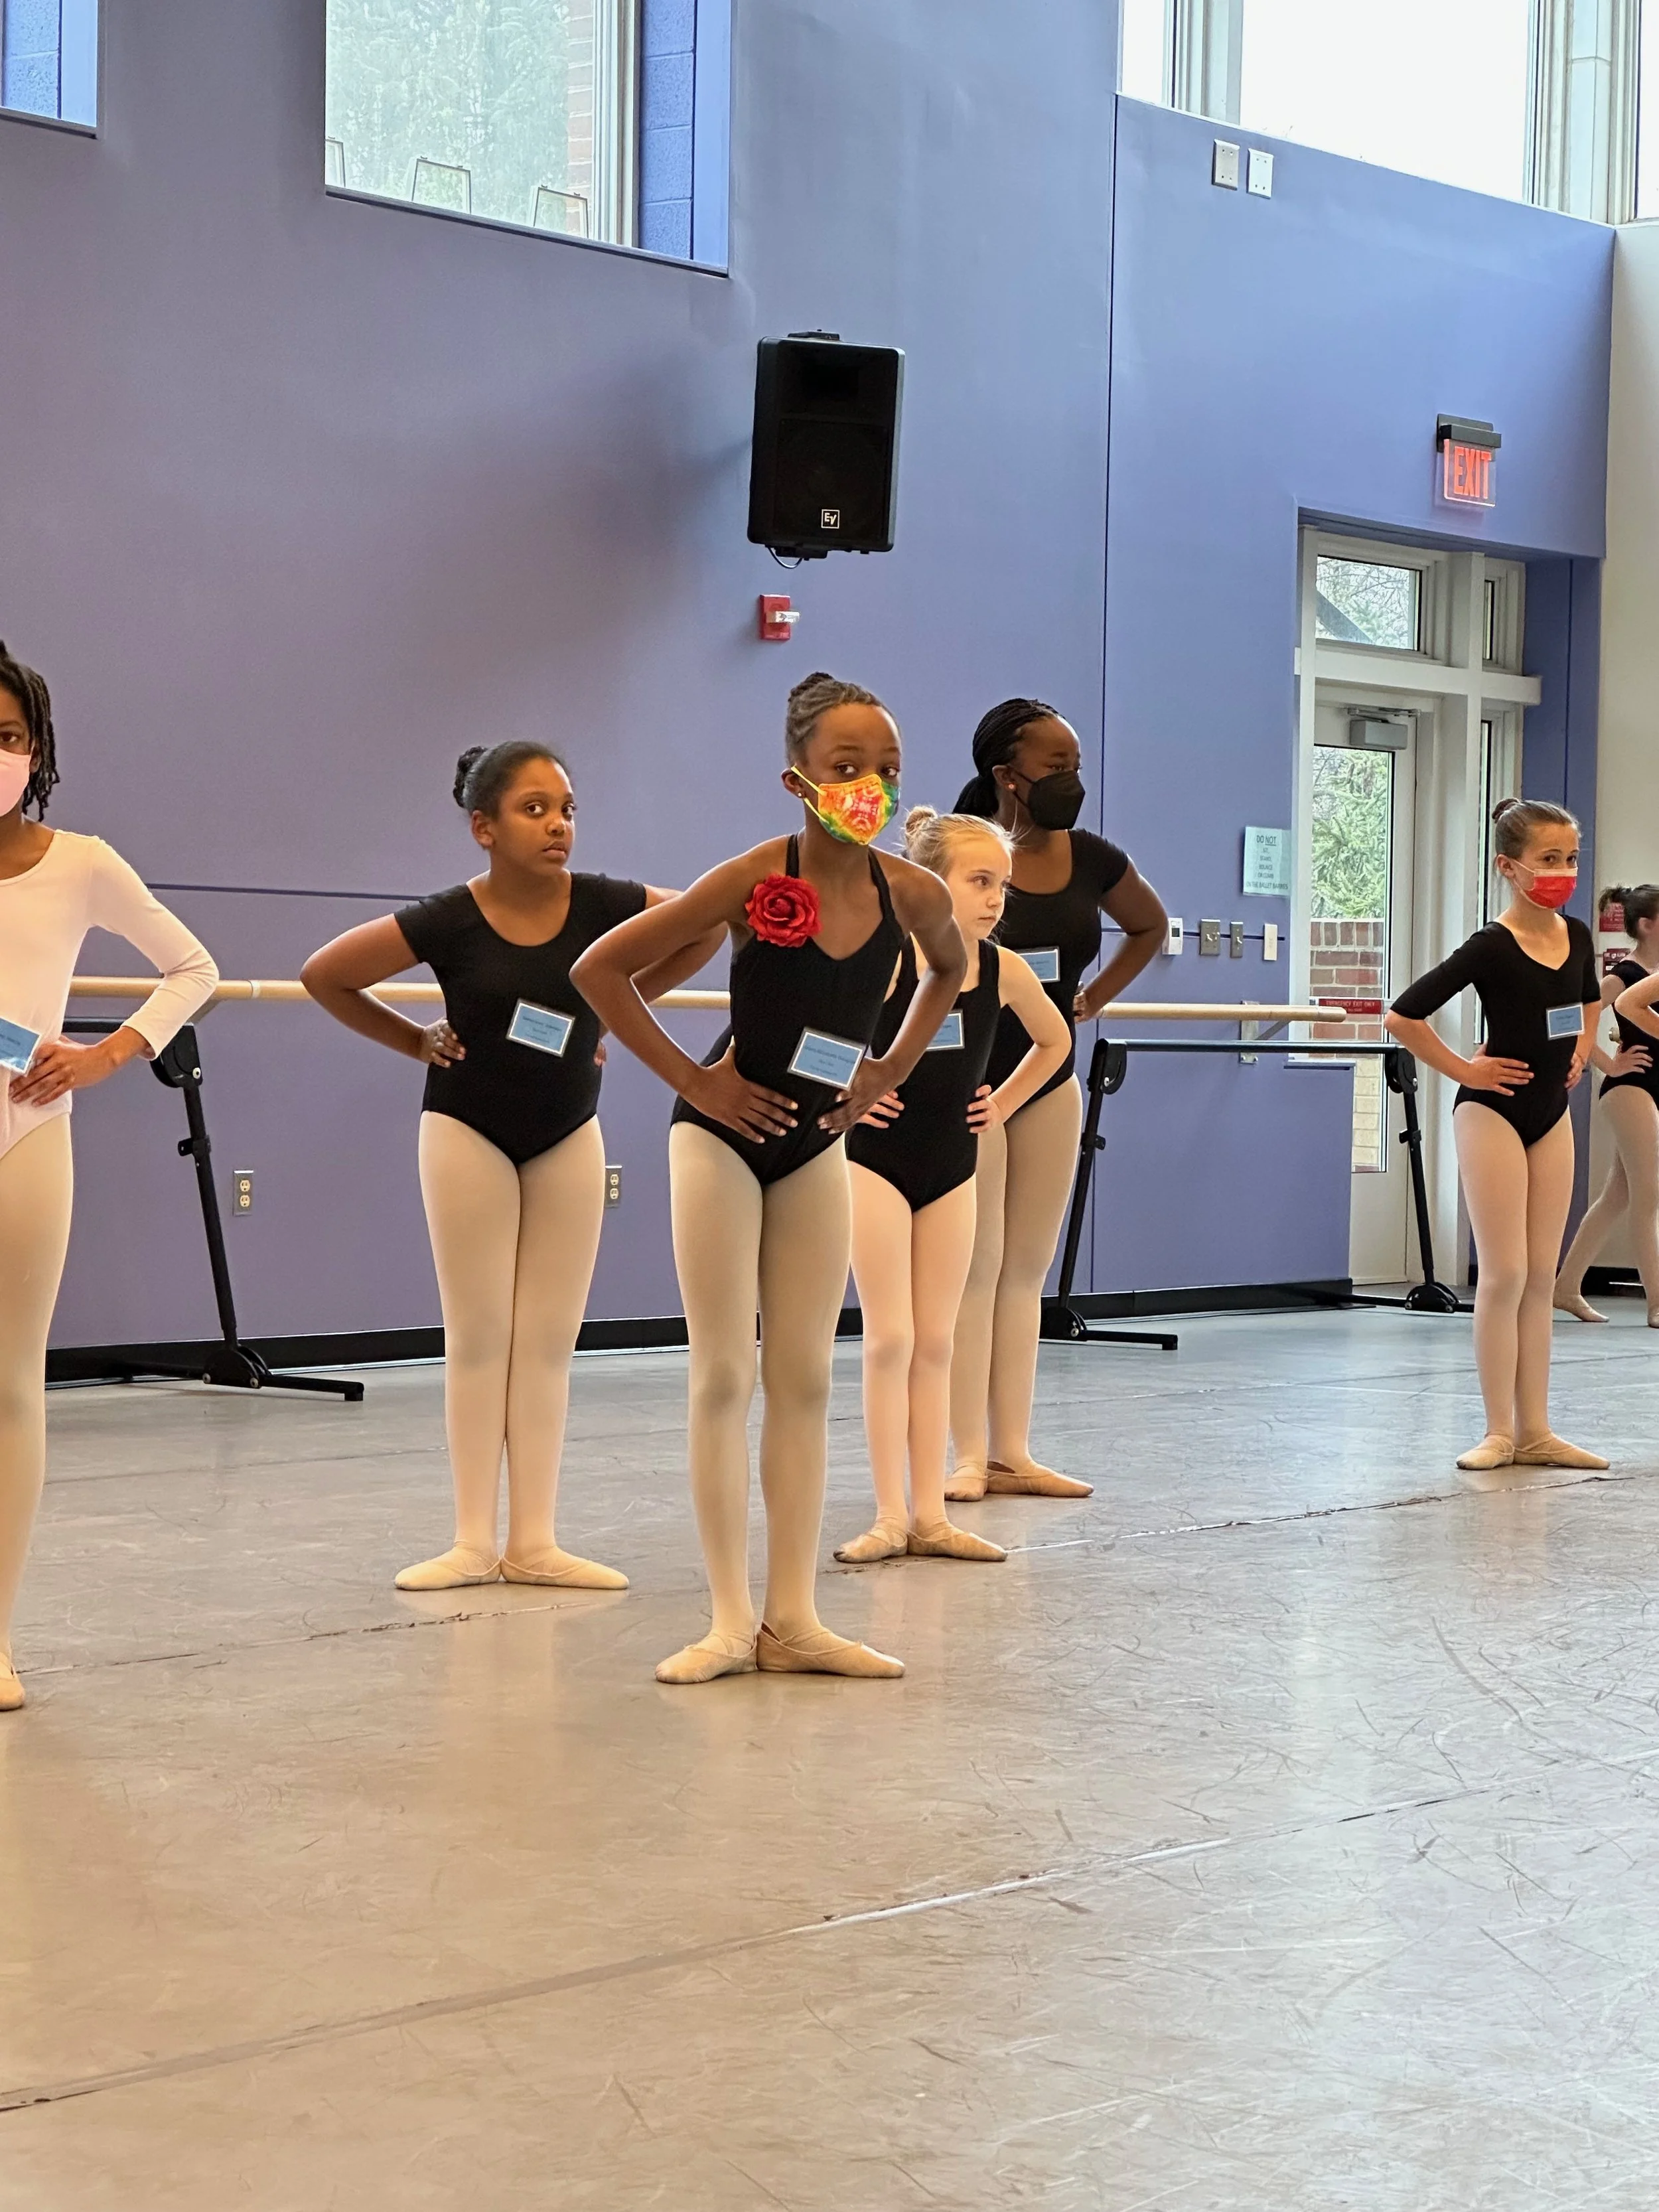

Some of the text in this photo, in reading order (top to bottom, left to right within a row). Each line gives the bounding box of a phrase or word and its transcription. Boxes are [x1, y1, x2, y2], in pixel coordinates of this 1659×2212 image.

[1454, 446, 1492, 499] EXIT
[1256, 835, 1277, 844] DO NOT
